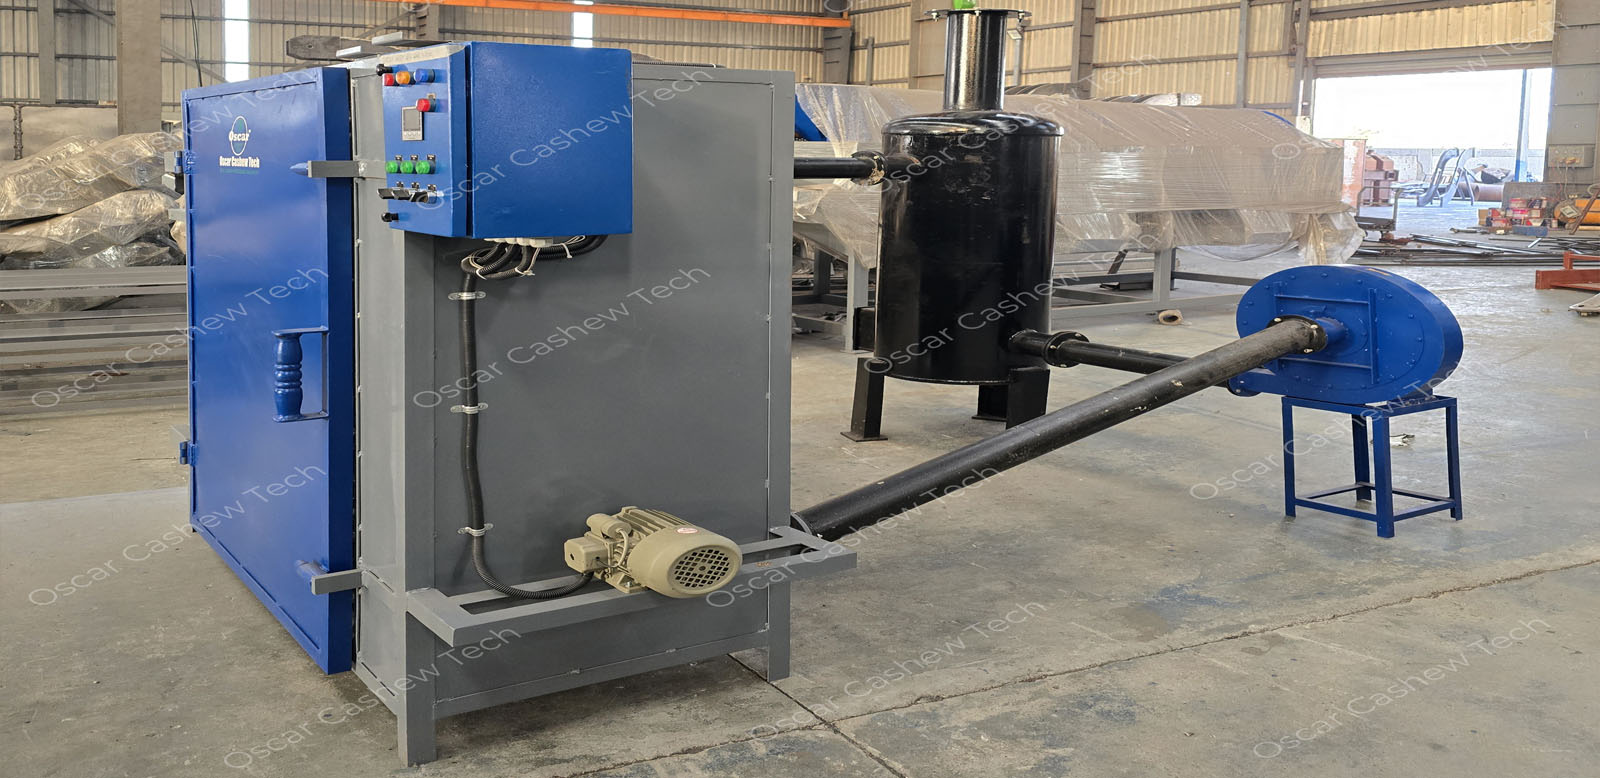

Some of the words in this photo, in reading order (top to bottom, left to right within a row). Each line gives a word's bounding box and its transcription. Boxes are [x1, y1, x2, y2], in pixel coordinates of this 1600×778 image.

[229, 130, 249, 141] Oscar
[219, 155, 231, 167] Oscar
[249, 156, 260, 168] Tech
